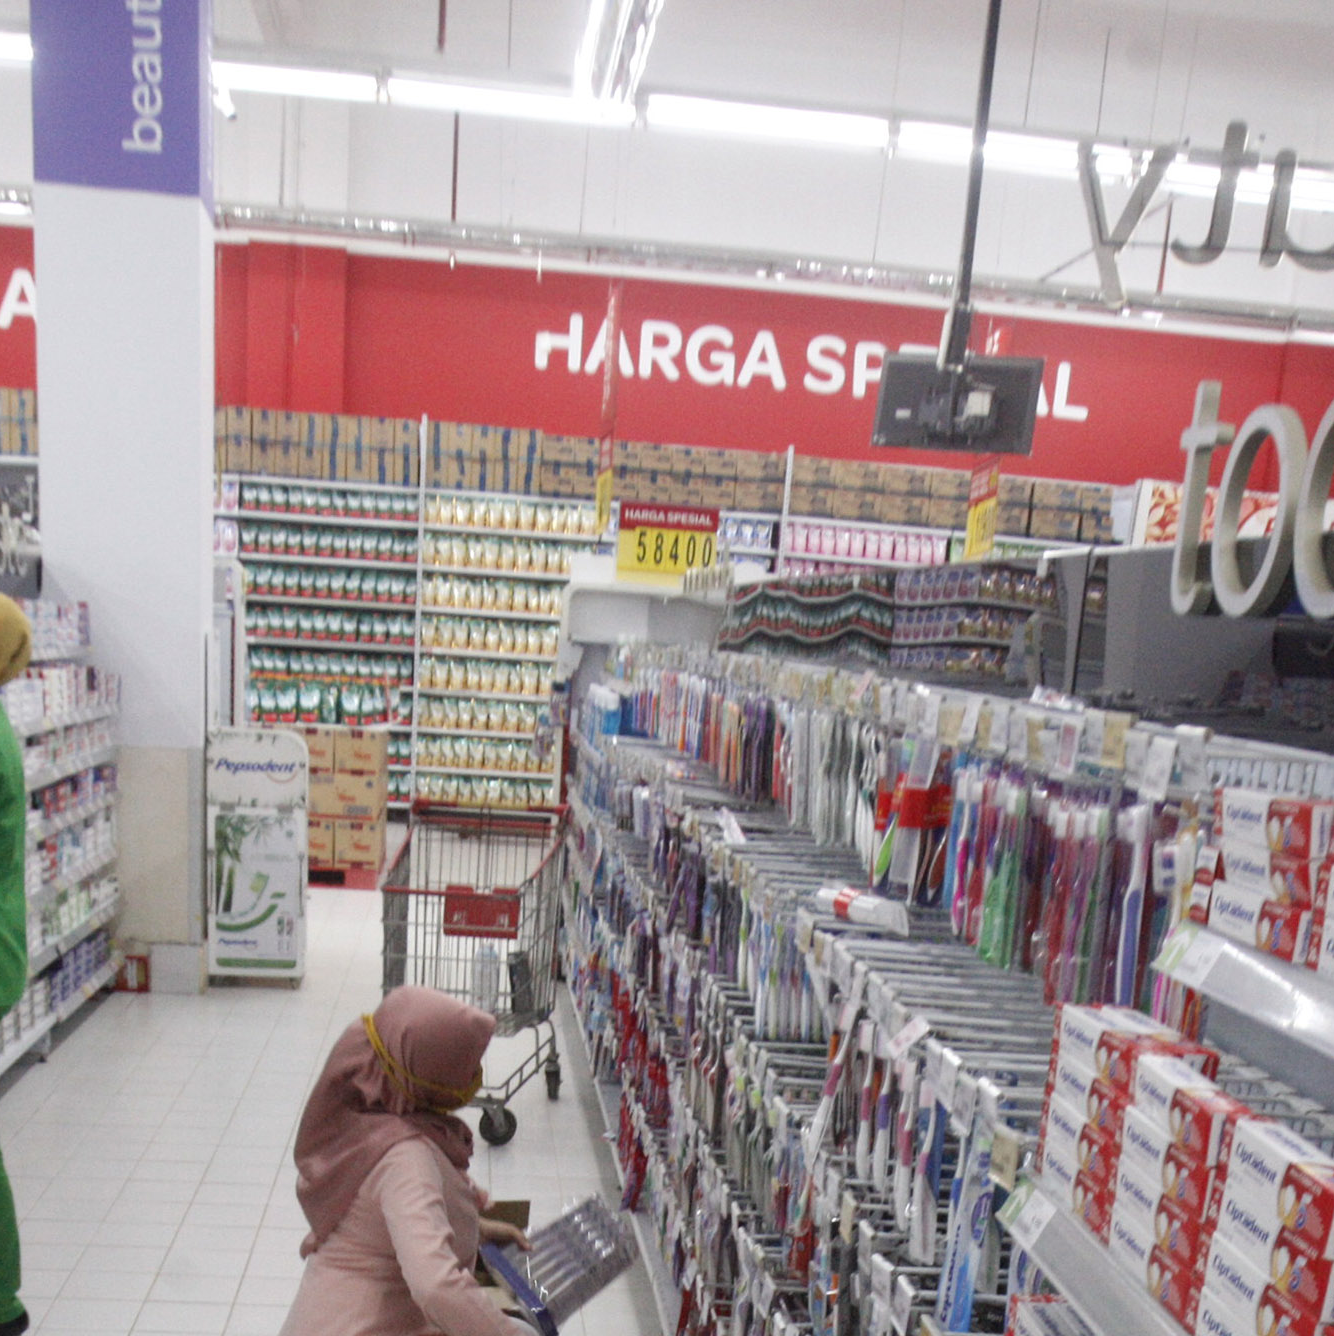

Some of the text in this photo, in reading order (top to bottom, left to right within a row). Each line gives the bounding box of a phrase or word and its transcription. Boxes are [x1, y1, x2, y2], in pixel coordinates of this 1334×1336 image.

[121, 0, 163, 154] beaut
[534, 312, 787, 391] HARGA
[624, 505, 713, 528] HARGA SPESIAL
[635, 530, 713, 570] 58400
[215, 756, 296, 775] Pepsodent
[1235, 1142, 1277, 1184] Ciptadent
[1226, 1200, 1270, 1245] Ciptadent
[1212, 1254, 1255, 1302] Ciptadent
